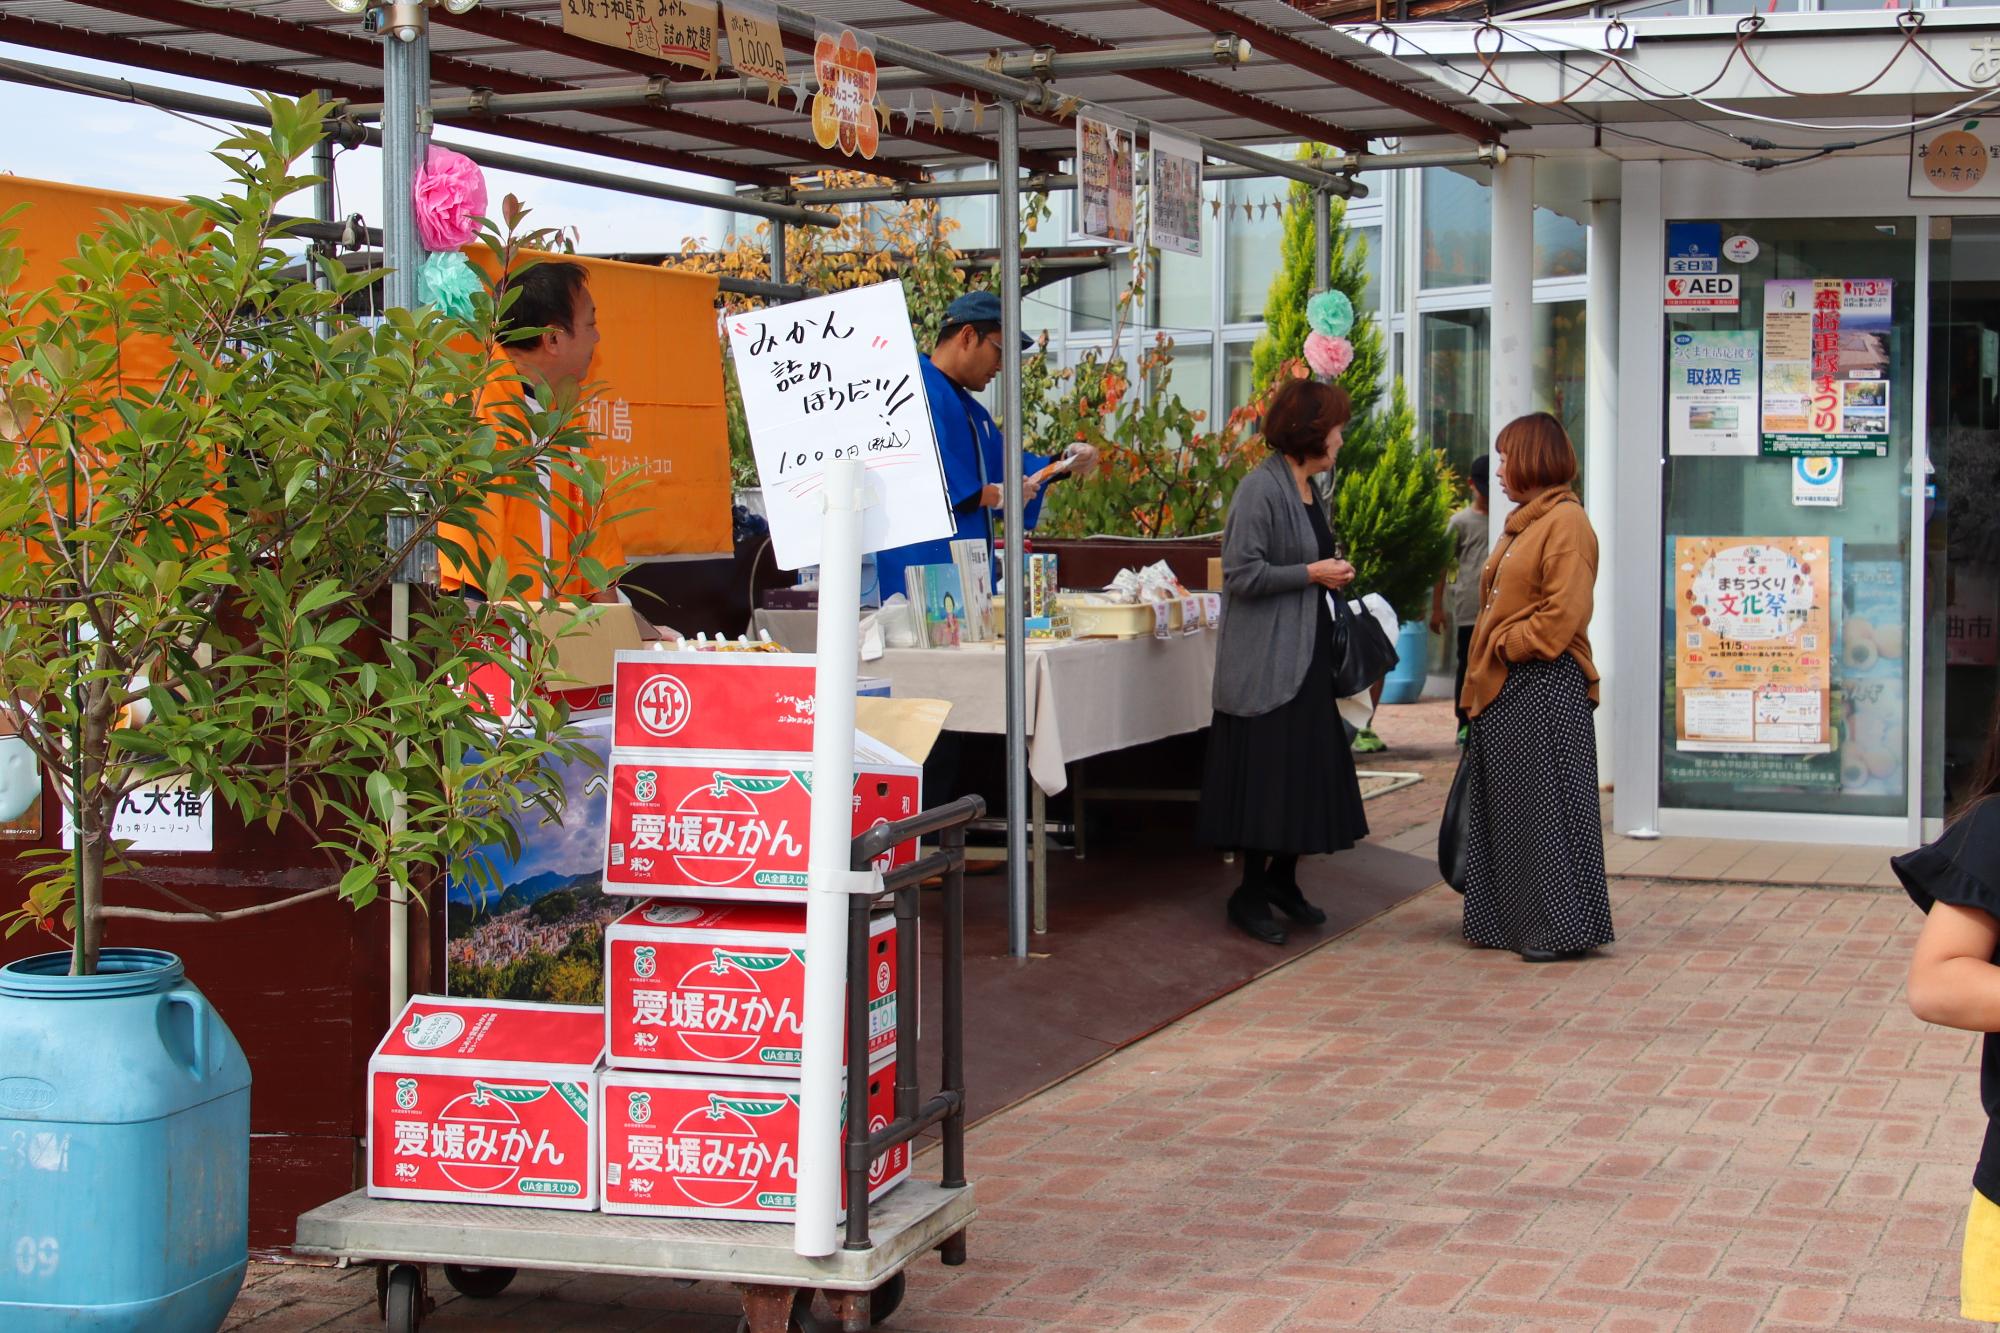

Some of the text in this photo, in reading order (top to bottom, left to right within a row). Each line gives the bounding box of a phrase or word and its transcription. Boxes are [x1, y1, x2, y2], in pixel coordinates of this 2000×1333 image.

[663, 23, 712, 50] 詰め放題
[1930, 165, 1982, 181] 物産館
[1688, 278, 1733, 294] AED
[749, 310, 855, 357] みかん
[1812, 288, 1842, 433] 森将軍塚まつり
[770, 359, 833, 393] 詰め
[1686, 367, 1742, 386] 取扱店
[580, 396, 633, 444] 和島
[1736, 565, 1769, 575] ちくま
[1718, 576, 1787, 591] まちづくり
[1717, 592, 1788, 618] 文化祭
[1718, 641, 1742, 651] 11/5
[121, 784, 203, 818] ん大福
[629, 813, 803, 857] 愛媛みかん
[629, 857, 655, 872] ポン
[632, 988, 804, 1035] 愛媛みかん
[633, 1032, 659, 1047] ポン
[394, 1119, 565, 1166] 愛媛みかん
[627, 1134, 798, 1180] 愛媛みかん
[395, 1162, 420, 1179] ポン
[522, 1181, 577, 1194] JA全農えひめ
[628, 1178, 655, 1193] ポン
